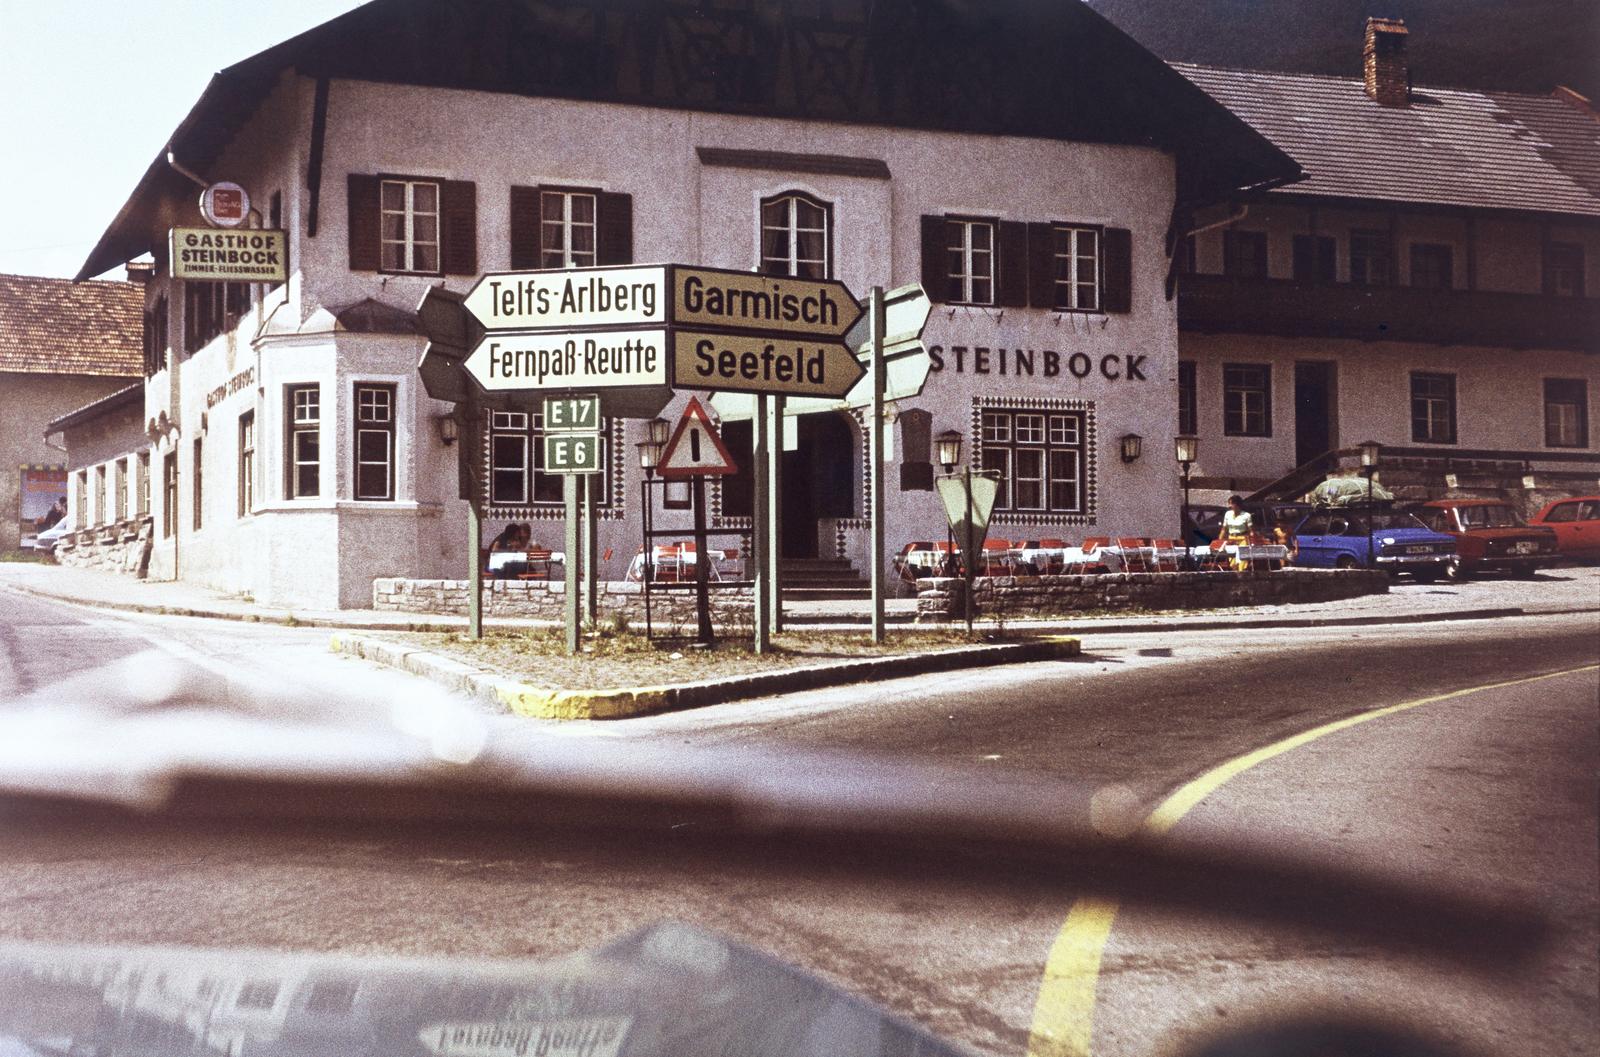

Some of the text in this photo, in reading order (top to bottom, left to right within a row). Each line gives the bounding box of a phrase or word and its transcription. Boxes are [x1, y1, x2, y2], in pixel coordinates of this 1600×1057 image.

[181, 249, 280, 265] STEINBOCK
[185, 233, 276, 250] GASTHOF
[489, 277, 656, 317] Telfs-Arlberg
[684, 276, 839, 327] Garmisch
[489, 338, 657, 385] Fernpaß-Reutte
[695, 339, 825, 385] Seefeld
[928, 344, 1148, 382] STEINBOCK
[551, 400, 592, 424] E 17
[555, 441, 587, 465] E 6
